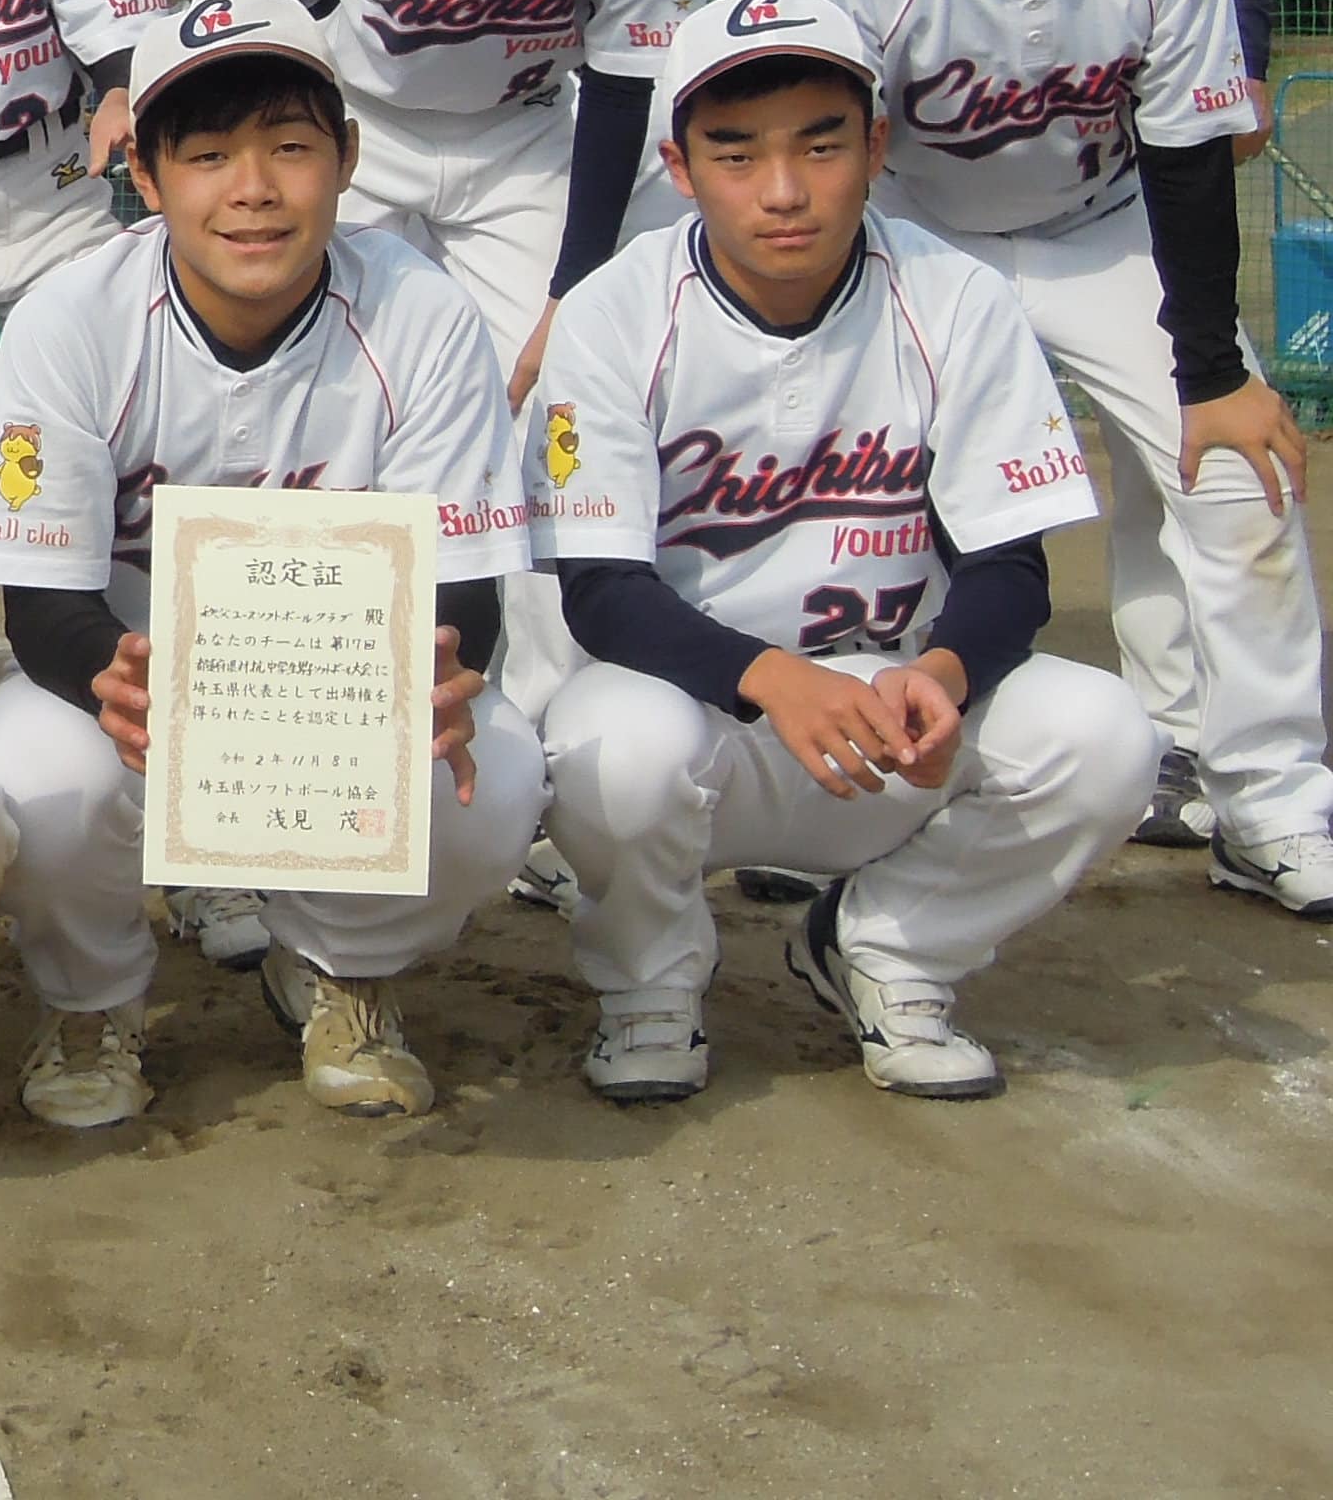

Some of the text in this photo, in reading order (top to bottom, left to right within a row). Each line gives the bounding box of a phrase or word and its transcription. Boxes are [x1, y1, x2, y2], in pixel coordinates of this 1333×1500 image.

[998, 447, 1085, 493] Saita
[573, 494, 615, 517] club
[27, 522, 70, 548] club
[832, 517, 933, 564] youth
[246, 557, 343, 588] 認定証
[799, 580, 930, 646] 27
[193, 680, 389, 703] 埼玉県代表として出場権を
[193, 705, 389, 728] 得られたことを認定します
[197, 779, 379, 801] 埼玉県ソフトボール協会
